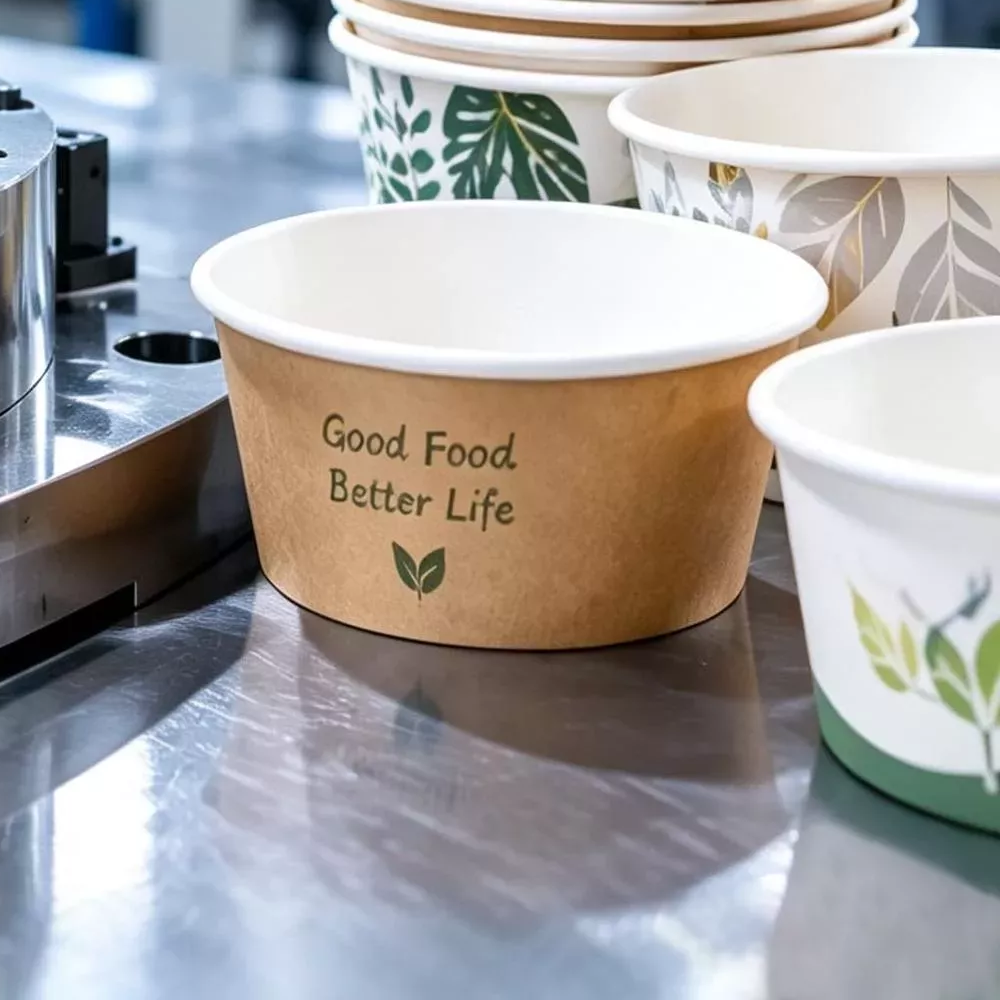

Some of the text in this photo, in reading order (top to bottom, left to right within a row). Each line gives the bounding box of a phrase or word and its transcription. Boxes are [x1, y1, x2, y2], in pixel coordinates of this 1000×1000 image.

[322, 413, 517, 470] Good Food
[329, 467, 515, 532] Better Life
